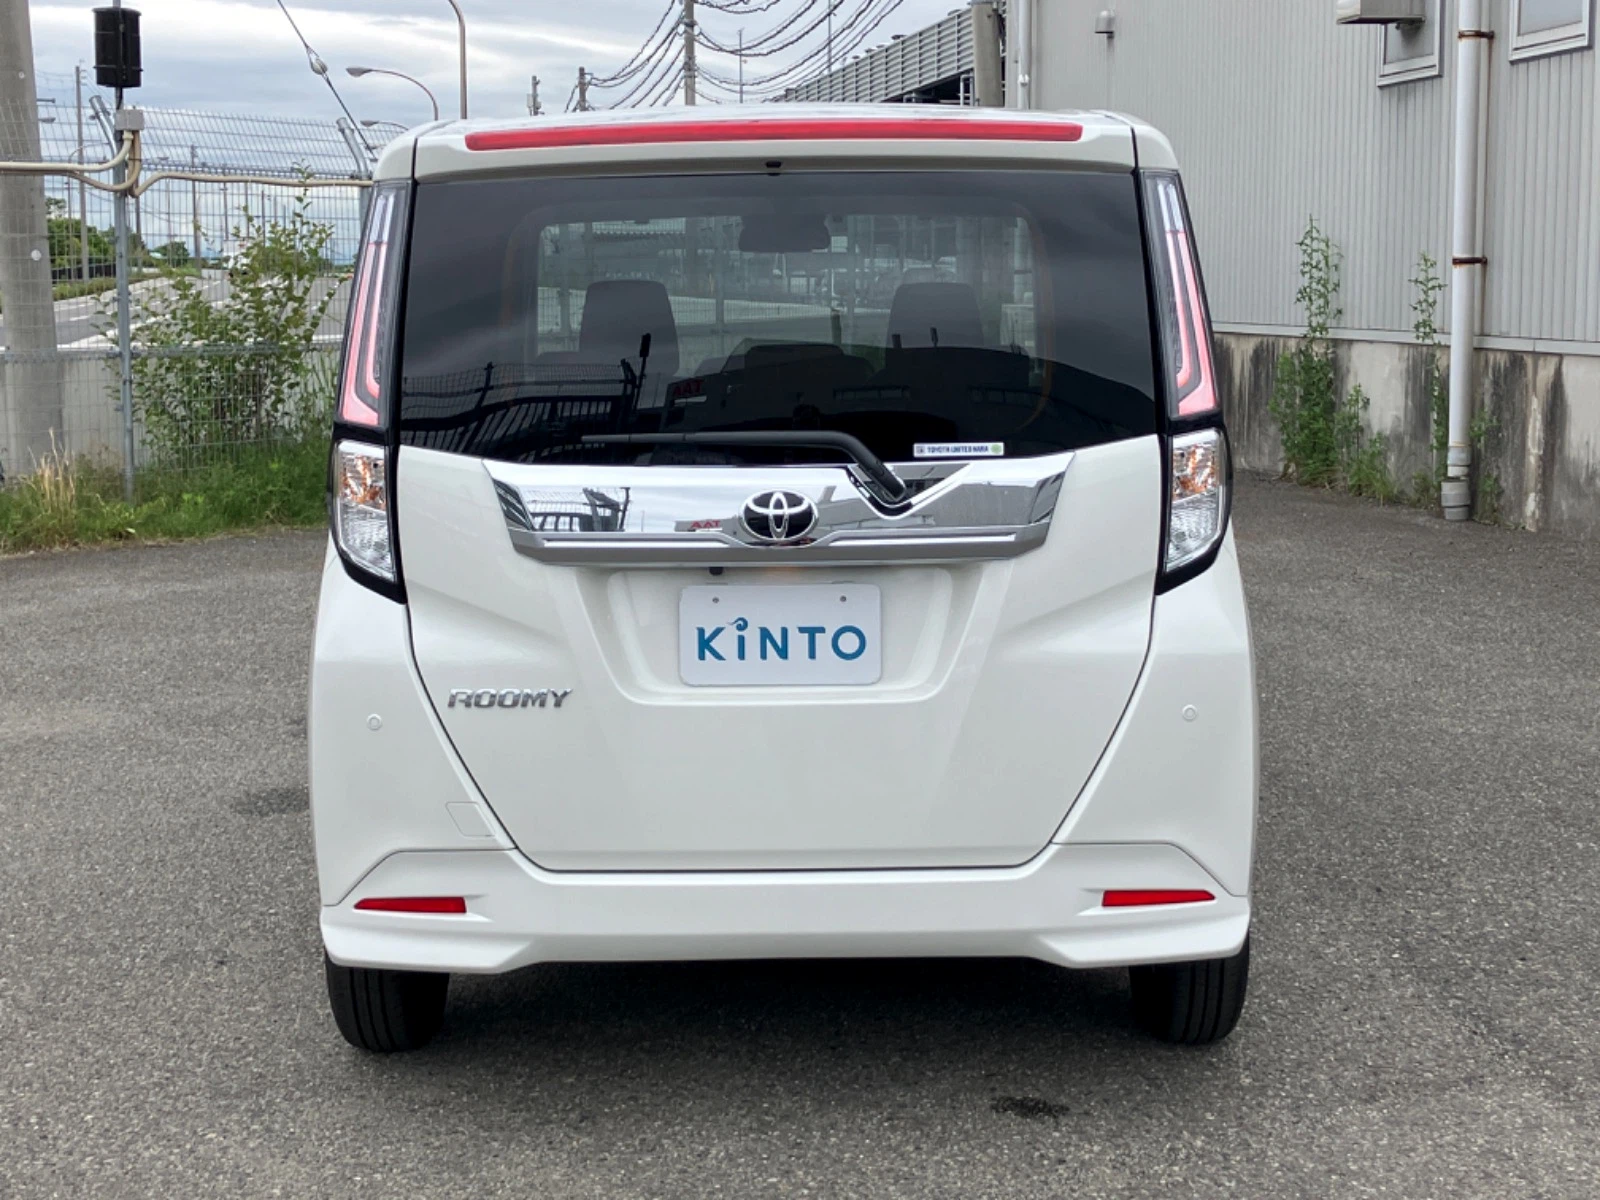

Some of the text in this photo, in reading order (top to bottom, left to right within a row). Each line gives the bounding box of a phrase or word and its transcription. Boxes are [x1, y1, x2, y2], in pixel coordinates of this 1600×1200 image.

[927, 446, 950, 454] TOYOTA
[951, 445, 972, 453] UNITED
[447, 688, 573, 709] ROOMY
